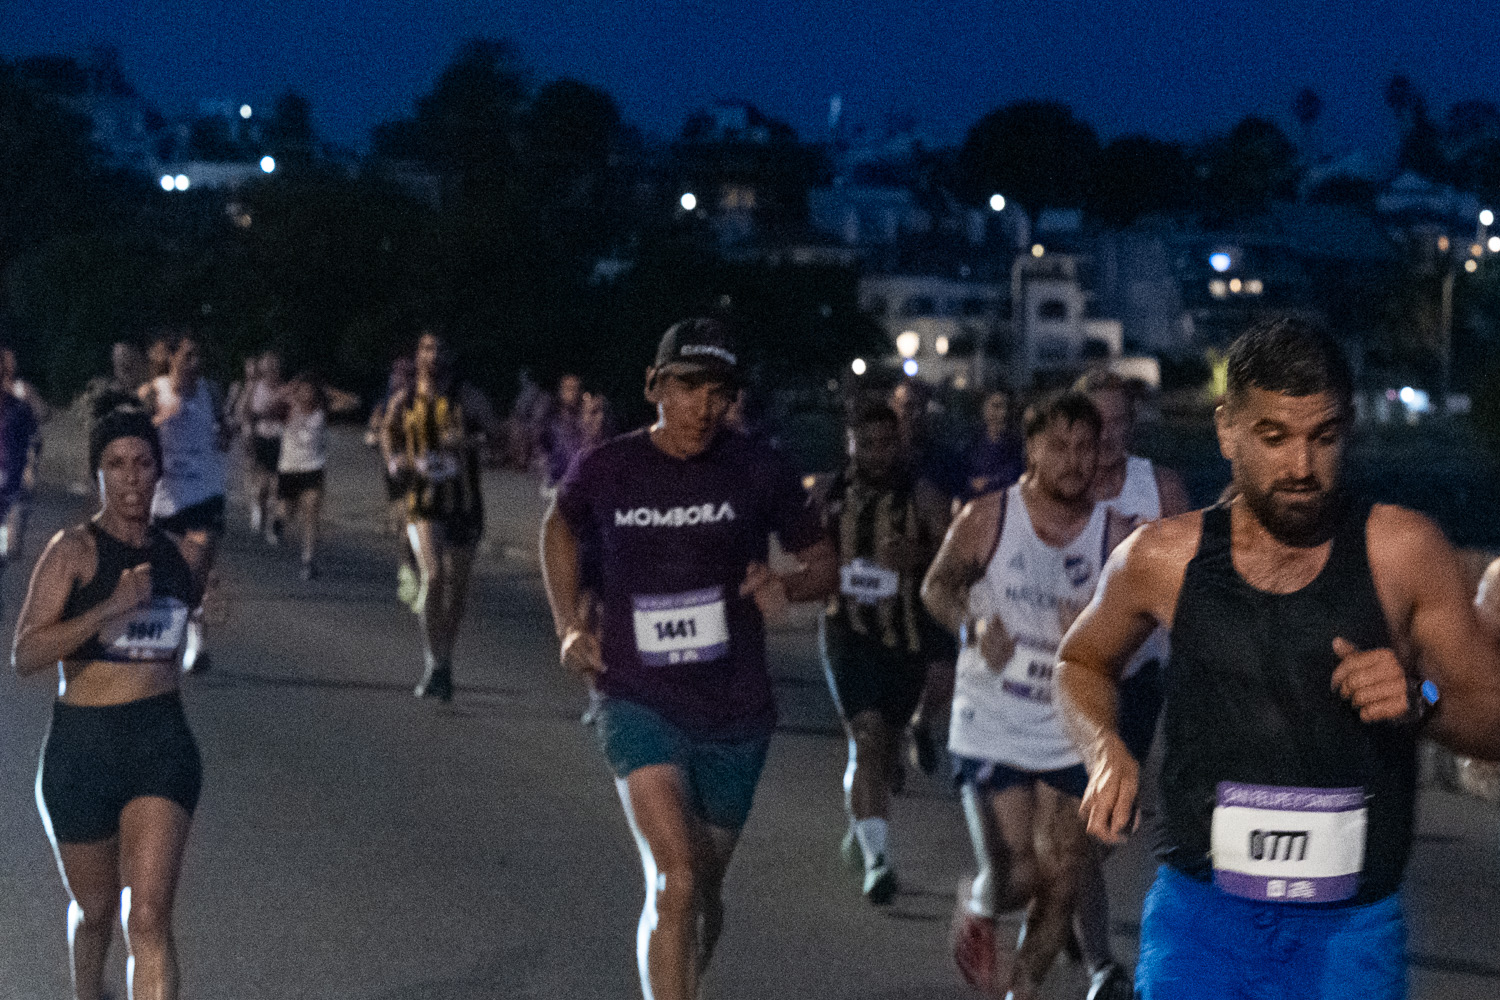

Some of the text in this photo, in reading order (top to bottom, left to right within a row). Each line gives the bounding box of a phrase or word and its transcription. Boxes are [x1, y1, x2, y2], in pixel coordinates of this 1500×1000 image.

[615, 502, 735, 526] MOMBORA
[654, 618, 697, 641] 1441
[1250, 829, 1309, 861] 0777
